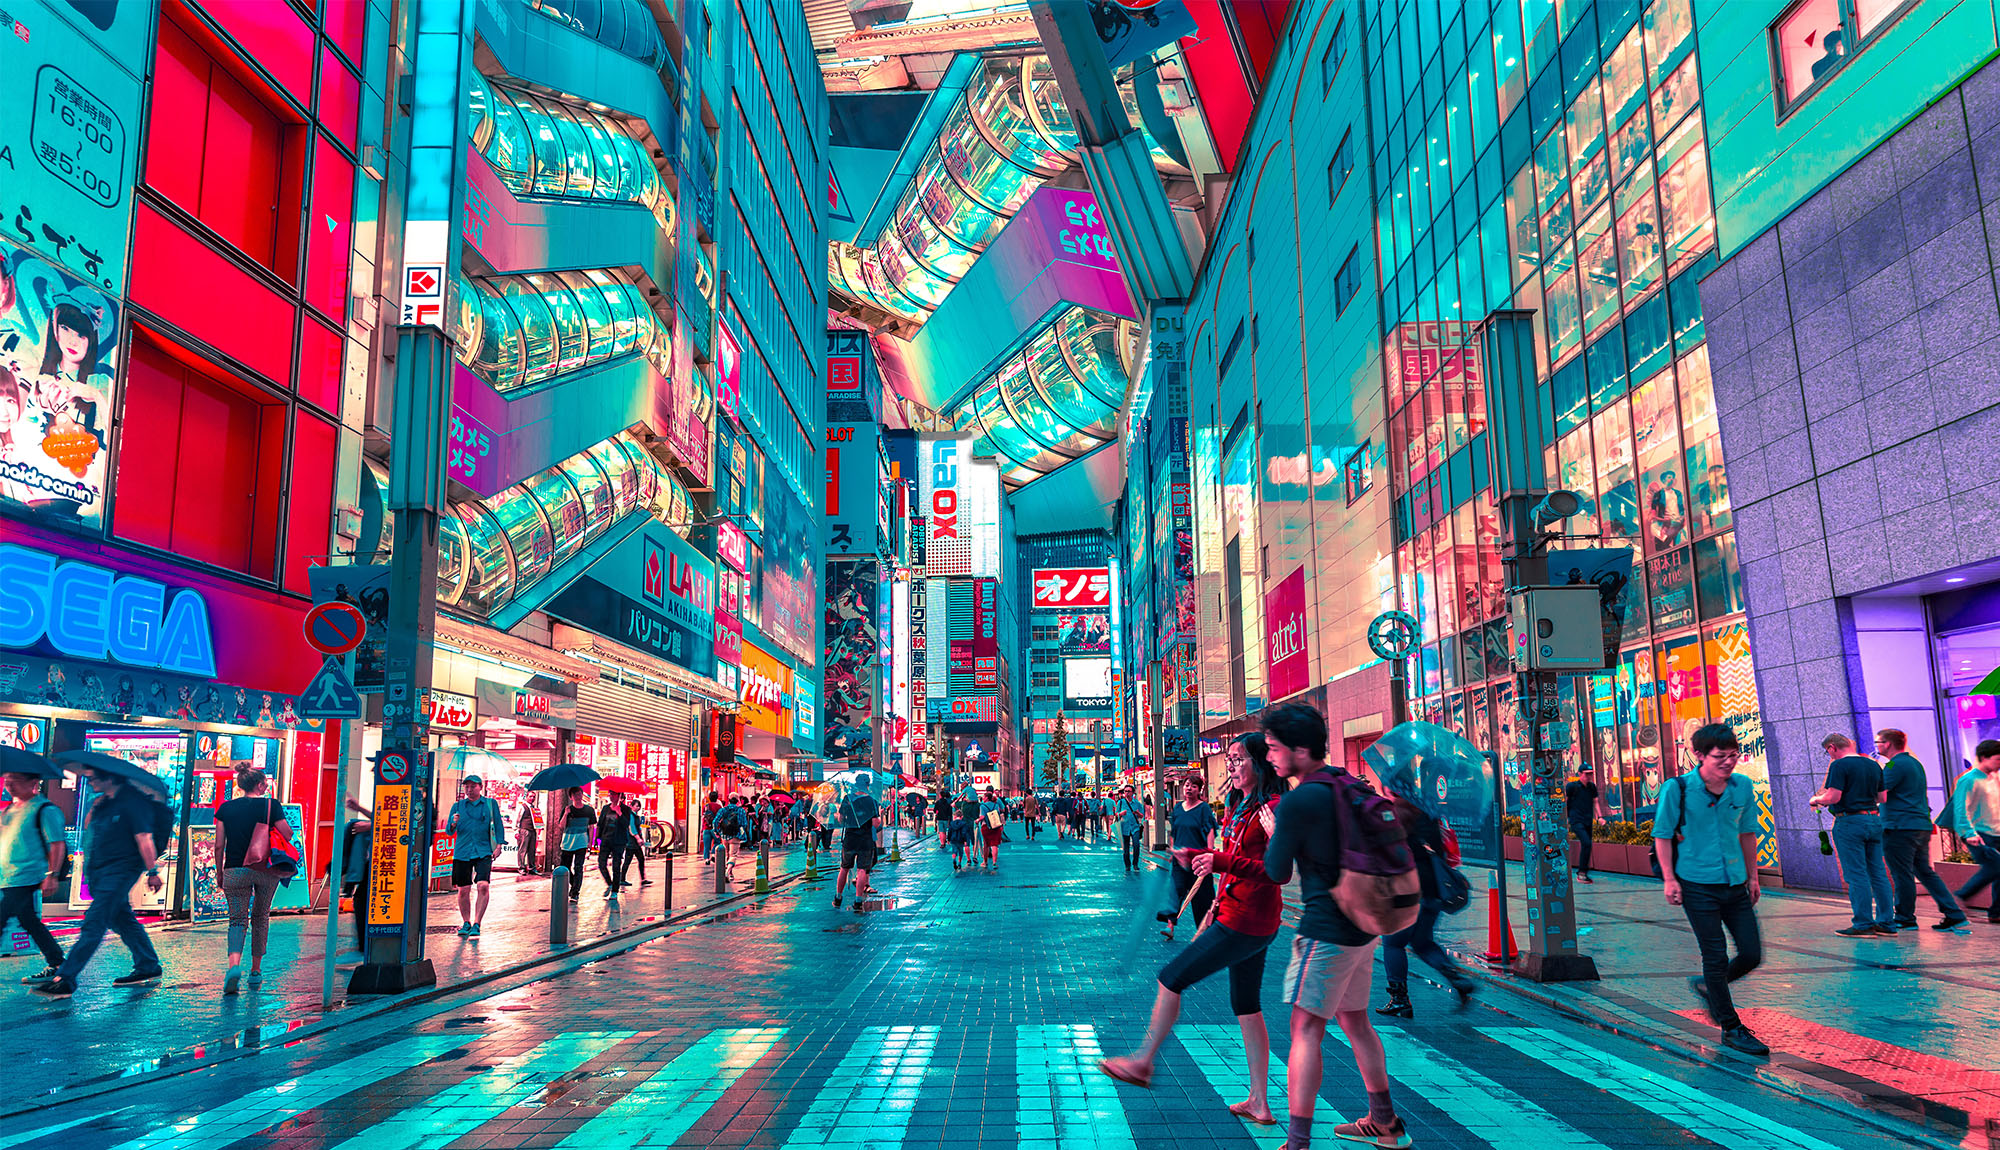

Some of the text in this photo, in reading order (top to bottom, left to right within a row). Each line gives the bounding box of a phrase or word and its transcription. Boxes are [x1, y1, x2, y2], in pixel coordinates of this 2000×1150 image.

[49, 93, 113, 154] 16:00
[54, 77, 112, 132] 営業時間
[669, 551, 712, 615] LABI
[981, 581, 996, 638] Duty Free
[0, 543, 217, 678] SEGA
[628, 608, 682, 659] パソコン館
[668, 599, 712, 636] AKIHABARA
[527, 694, 550, 713] LABI
[1076, 698, 1107, 706] TOKYO
[399, 788, 410, 831] 千代田区内は
[378, 795, 400, 920] 路上喫煙禁止です。
[436, 838, 454, 851] au
